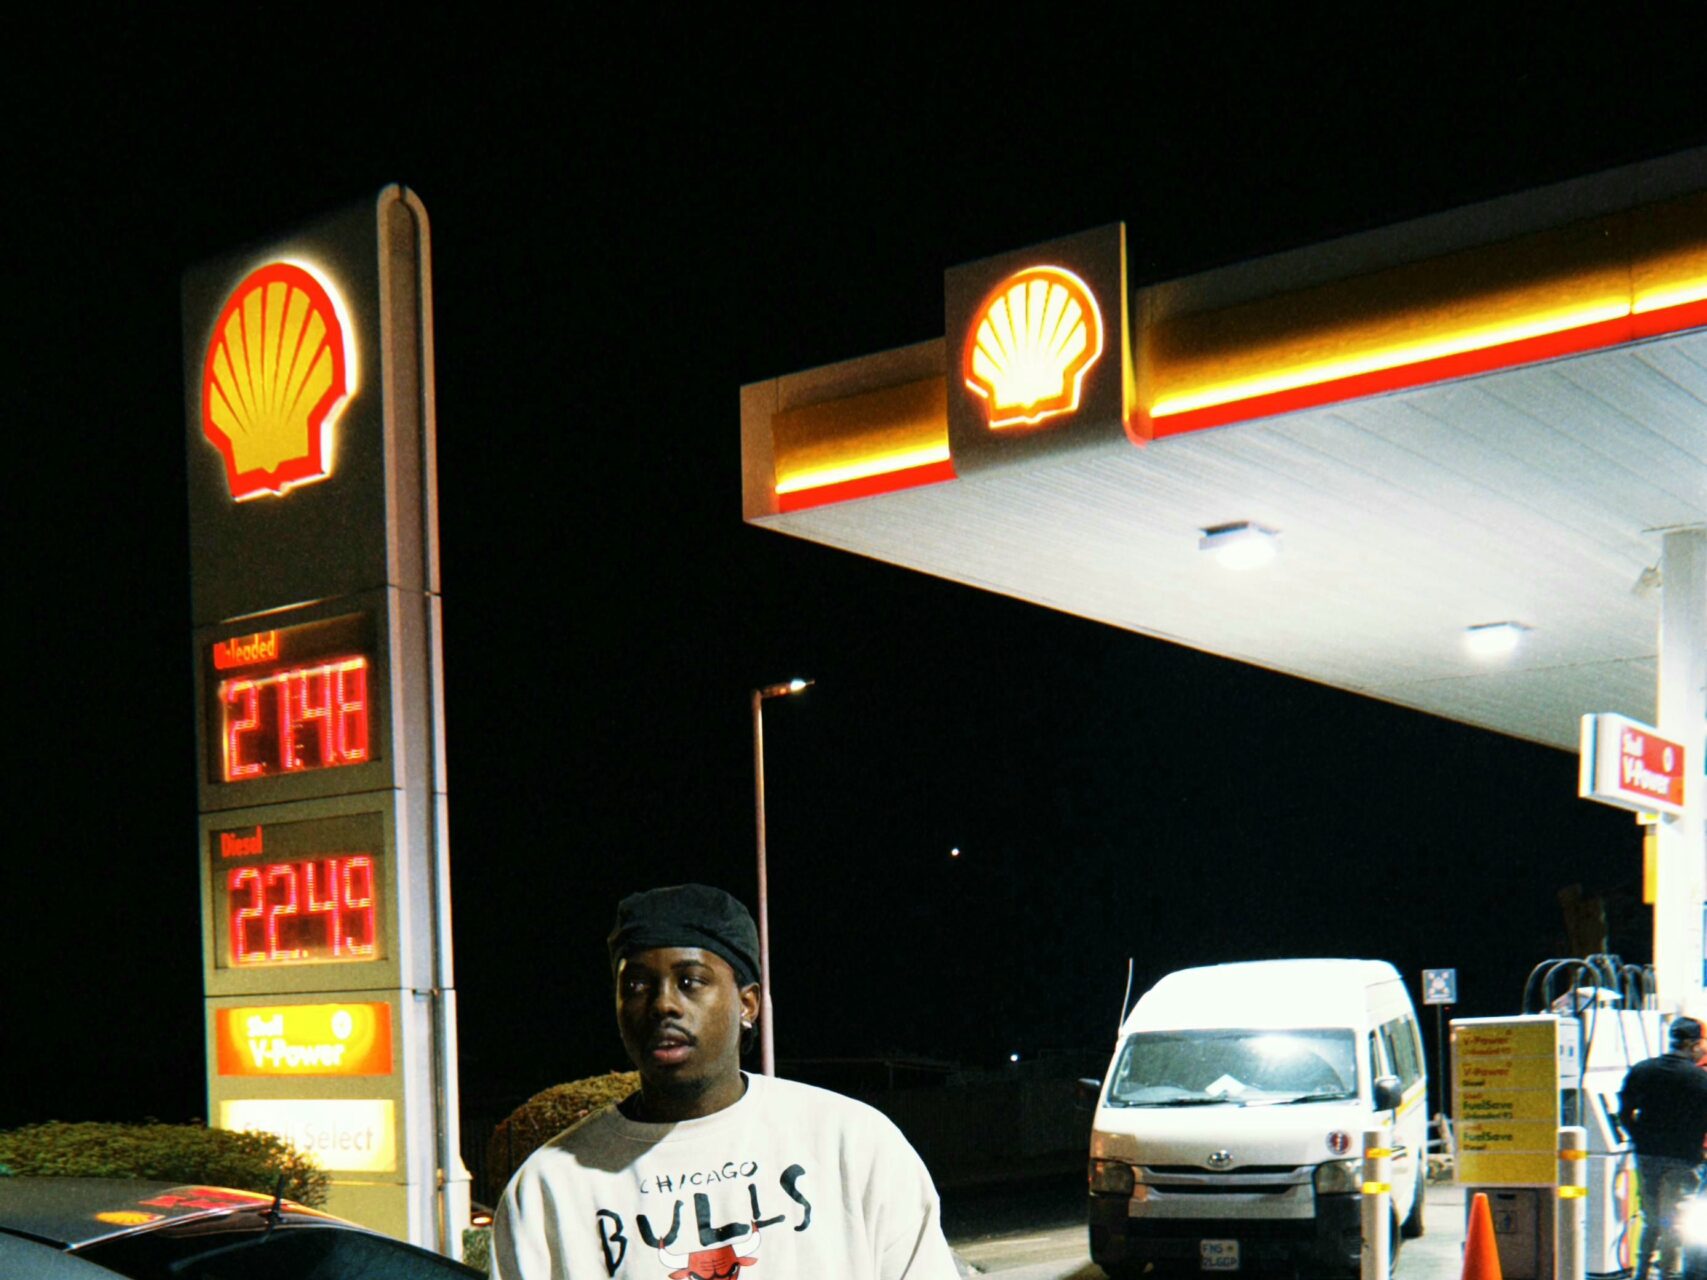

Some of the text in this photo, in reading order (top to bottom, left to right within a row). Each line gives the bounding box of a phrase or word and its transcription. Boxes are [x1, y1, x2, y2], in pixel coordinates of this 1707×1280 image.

[249, 1038, 344, 1068] V-Power
[303, 1121, 373, 1150] Select
[640, 1161, 758, 1194] CHICAGO
[596, 1163, 811, 1278] BULLS
